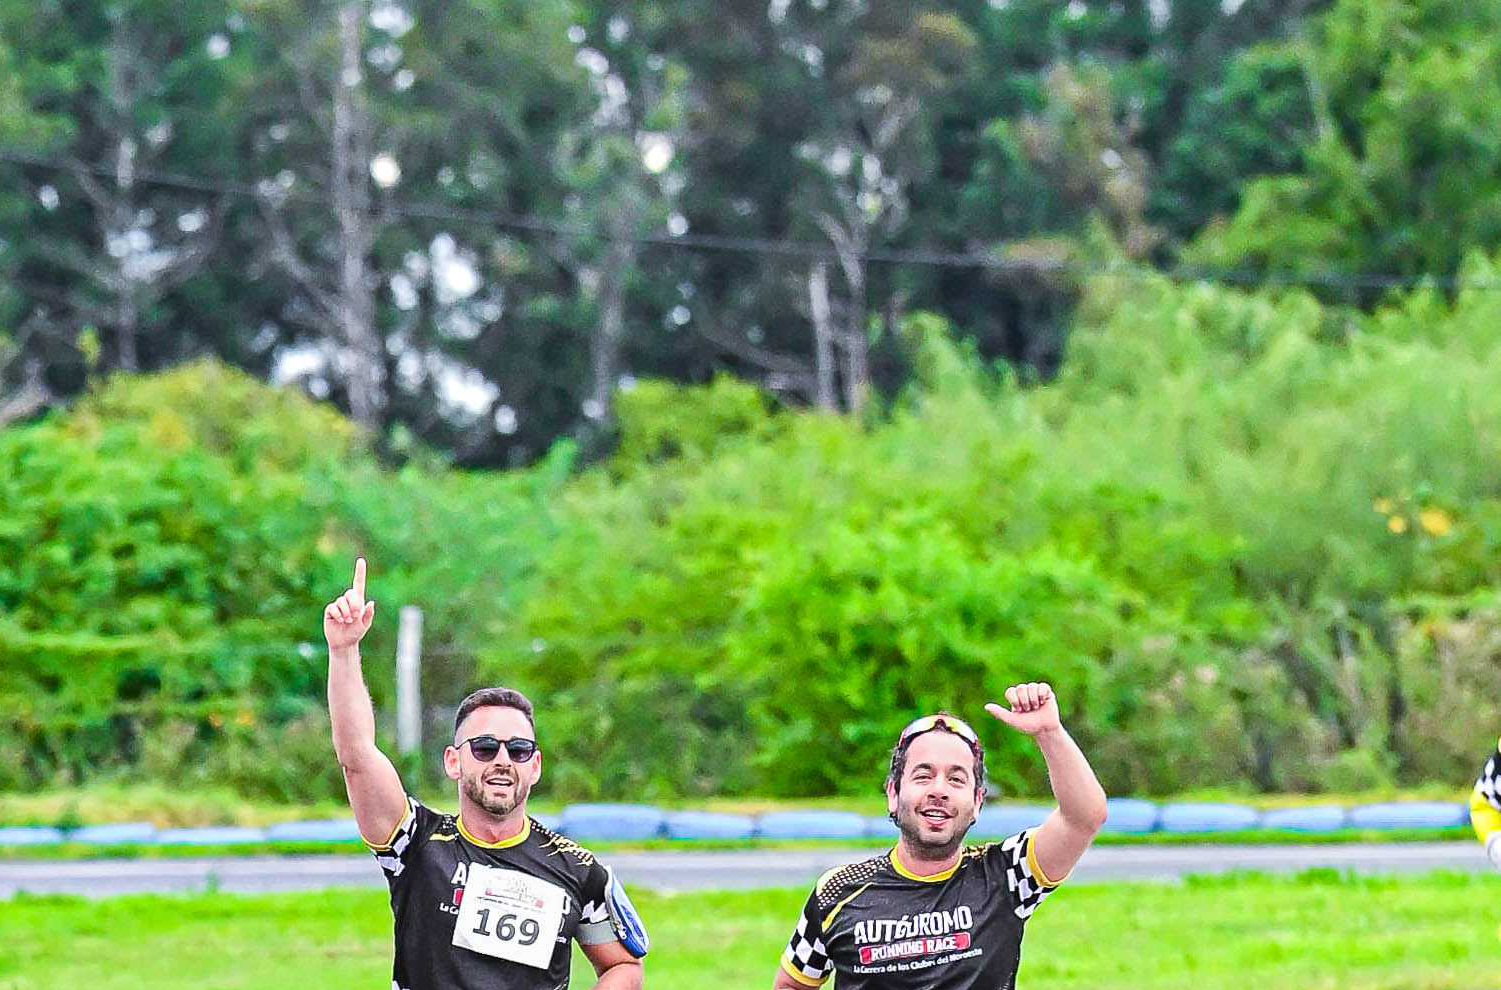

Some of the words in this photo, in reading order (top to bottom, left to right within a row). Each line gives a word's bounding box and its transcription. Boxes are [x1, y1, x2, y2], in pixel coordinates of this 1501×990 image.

[472, 908, 540, 946] 169
[871, 940, 924, 962] RUNNING
[926, 936, 957, 954] RACE
[886, 964, 897, 973] de
[898, 963, 910, 972] los
[937, 955, 949, 965] del
